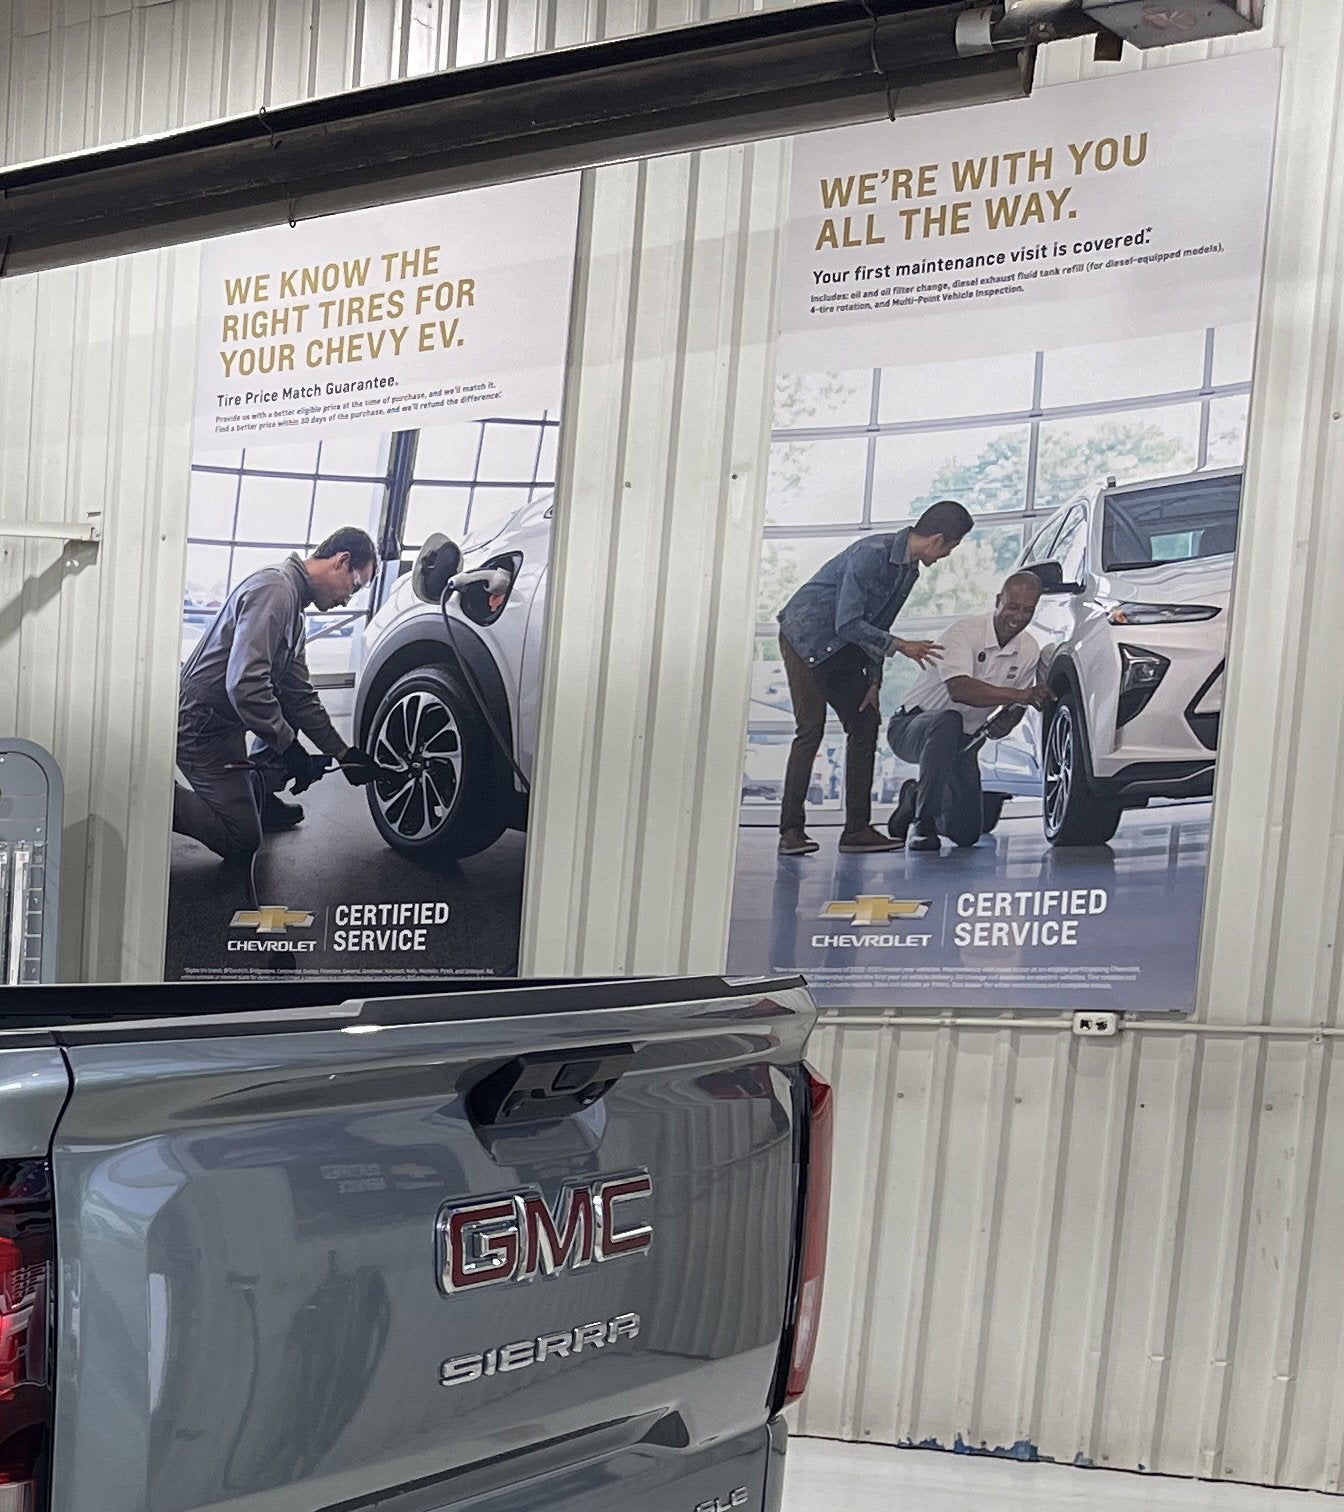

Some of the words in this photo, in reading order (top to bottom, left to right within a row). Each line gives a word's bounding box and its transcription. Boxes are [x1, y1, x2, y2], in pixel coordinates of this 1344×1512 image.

[820, 164, 939, 209] WE'RE
[952, 147, 1053, 192] WITH
[1067, 132, 1148, 175] YOU
[815, 214, 886, 250] ALL
[898, 201, 972, 240] THE
[985, 186, 1077, 230] WAY.
[224, 274, 271, 306] WE
[279, 257, 372, 299] KNOW
[381, 245, 441, 282] THE
[813, 270, 850, 285] Your
[854, 265, 891, 281] first
[896, 252, 1005, 276] maintenance
[1011, 244, 1047, 262] visit
[1053, 242, 1067, 257] is
[851, 290, 861, 299] oil
[862, 289, 879, 298] and
[880, 287, 891, 296] oil
[952, 277, 979, 288] diesel
[980, 273, 1015, 285] exhaust
[1017, 270, 1038, 281] fluid
[1040, 267, 1060, 277] tank
[1062, 263, 1084, 274] refill
[222, 304, 310, 342] RIGHT
[318, 289, 405, 329] TIRES
[415, 278, 476, 315] FOR
[874, 299, 891, 308] and
[942, 290, 973, 301] Vehicle
[219, 343, 296, 378] YOUR
[305, 326, 410, 368] CHEVY
[418, 318, 464, 352] EV.
[217, 394, 242, 407] Tire
[245, 389, 278, 404] Price
[282, 384, 321, 400] Match
[325, 376, 399, 395] Guarantee.
[335, 902, 450, 926] CERTIFIED
[956, 889, 1108, 916] CERTIFIED
[227, 940, 317, 952] CHEVROLET
[333, 929, 428, 951] SERVICE
[811, 934, 932, 948] CHEVROLET
[954, 920, 1079, 947] SERVICE
[433, 1166, 654, 1299] GMC
[438, 1312, 642, 1387] SIERRA
